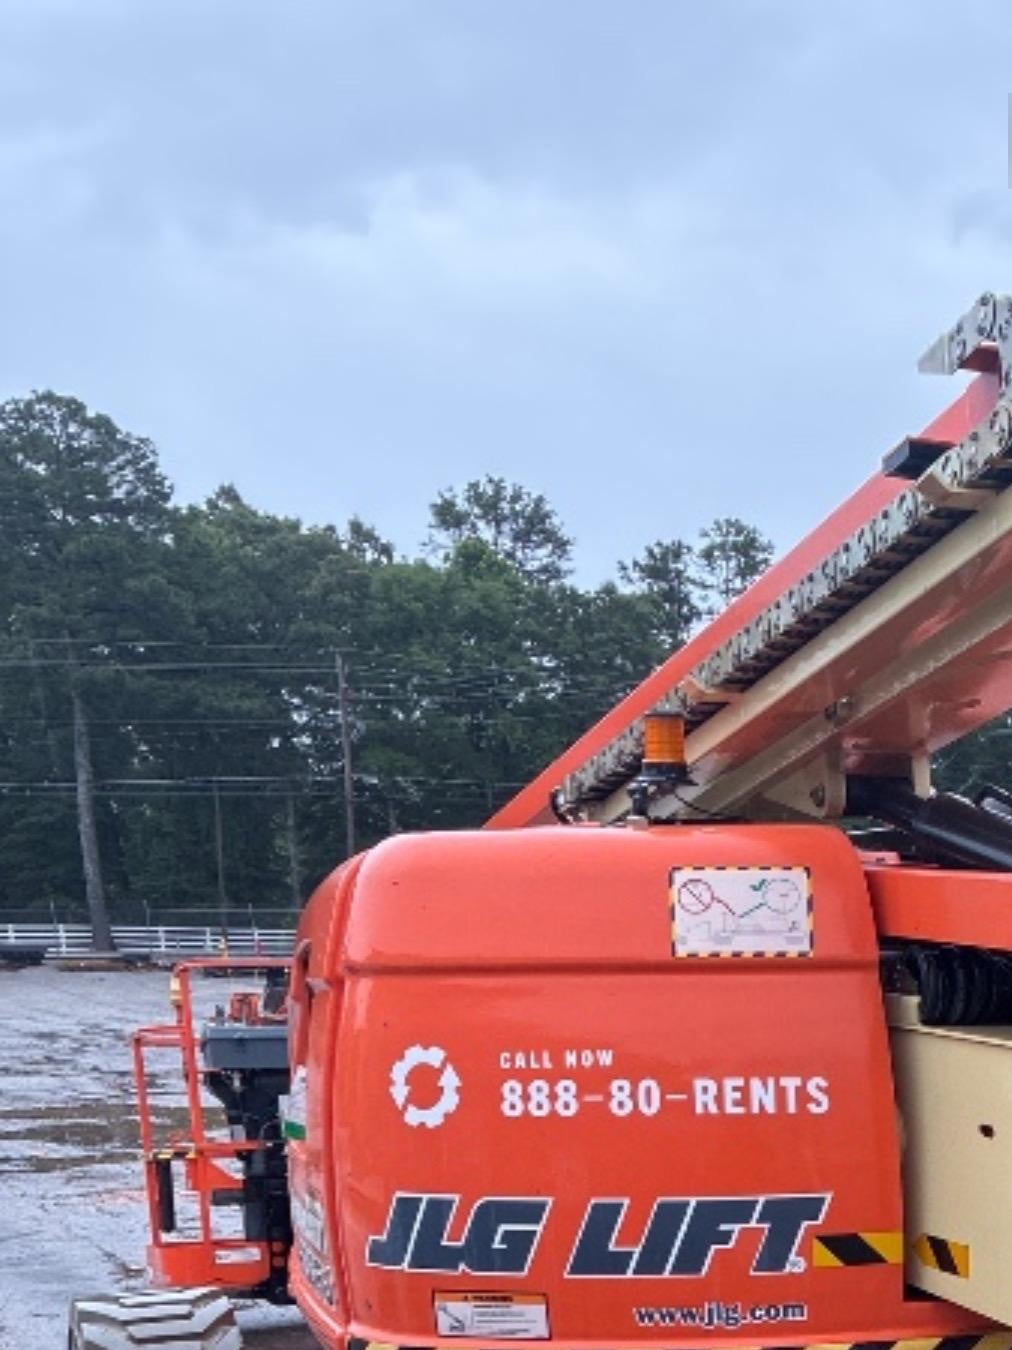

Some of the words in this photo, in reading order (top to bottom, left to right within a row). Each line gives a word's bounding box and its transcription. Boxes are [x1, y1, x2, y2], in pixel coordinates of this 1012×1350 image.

[499, 1051, 553, 1070] CALL
[564, 1049, 614, 1068] NOW
[500, 1076, 831, 1118] 888-80-RENTS
[365, 1191, 554, 1277] JLG
[632, 1300, 809, 1330] www.jlg.com
